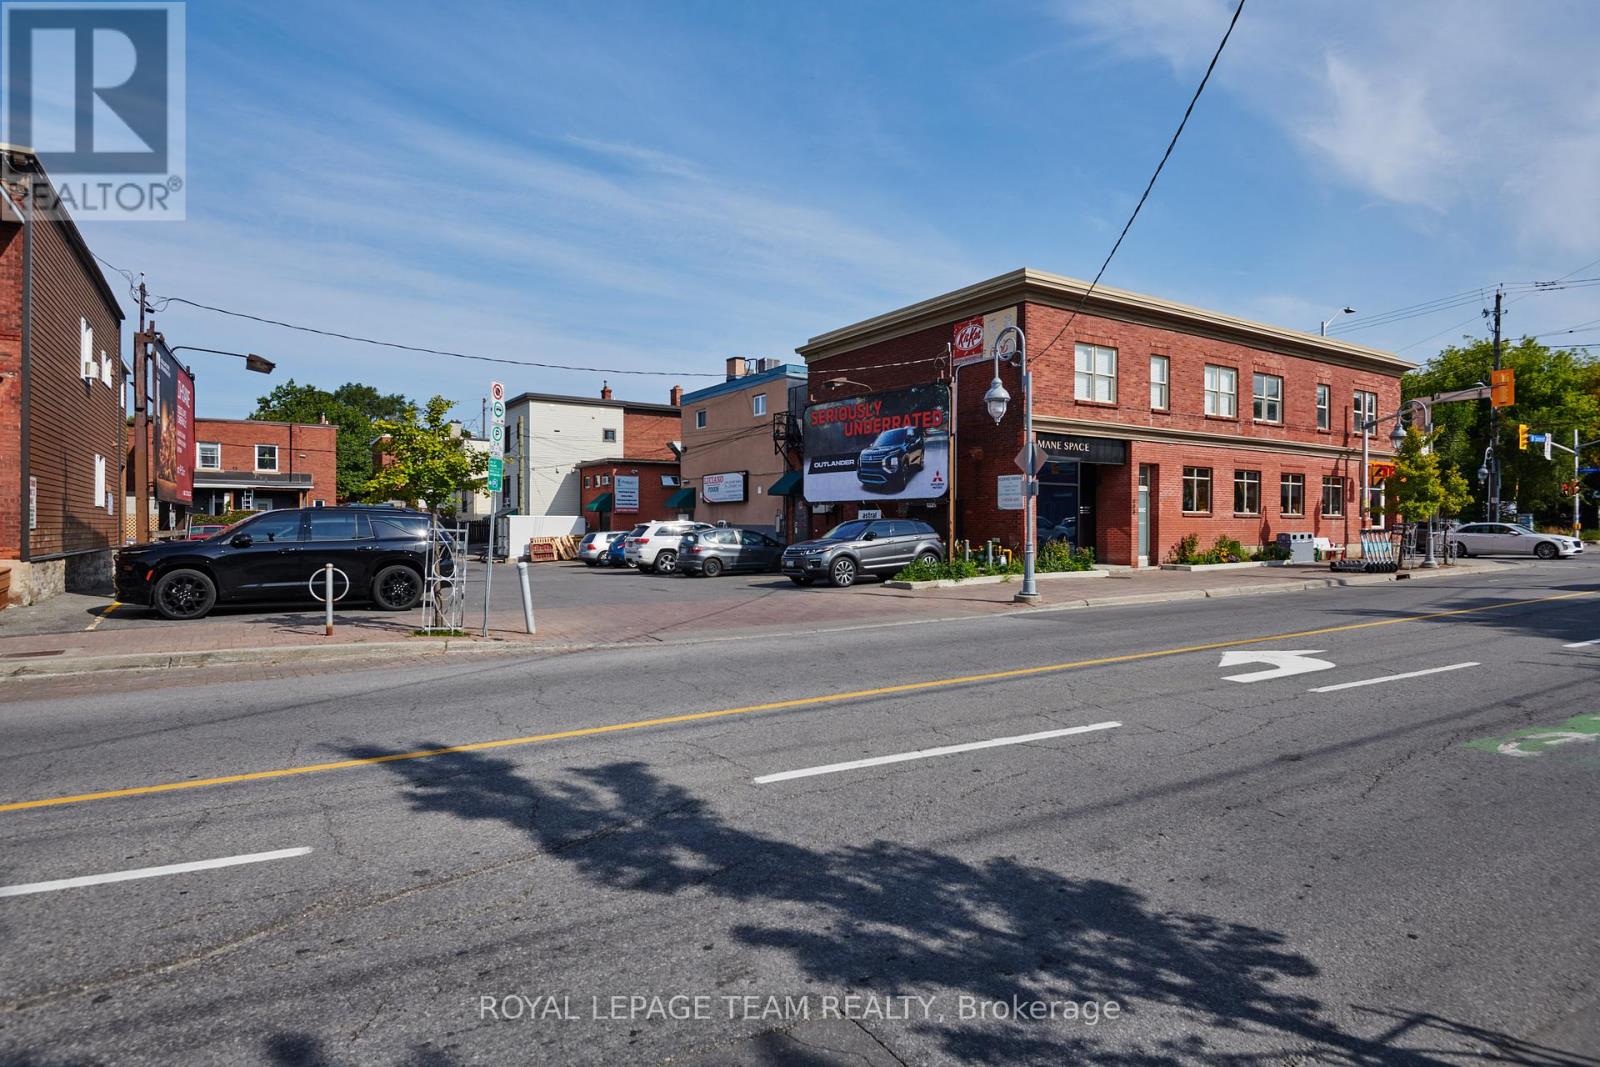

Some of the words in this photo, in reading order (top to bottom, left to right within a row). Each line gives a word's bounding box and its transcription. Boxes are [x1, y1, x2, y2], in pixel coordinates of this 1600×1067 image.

[811, 400, 882, 426] SERIOUSLY
[844, 410, 943, 437] UNDERRATED
[1037, 440, 1062, 450] MANE
[1063, 442, 1090, 452] SPACE
[813, 459, 855, 469] OUTLANDER
